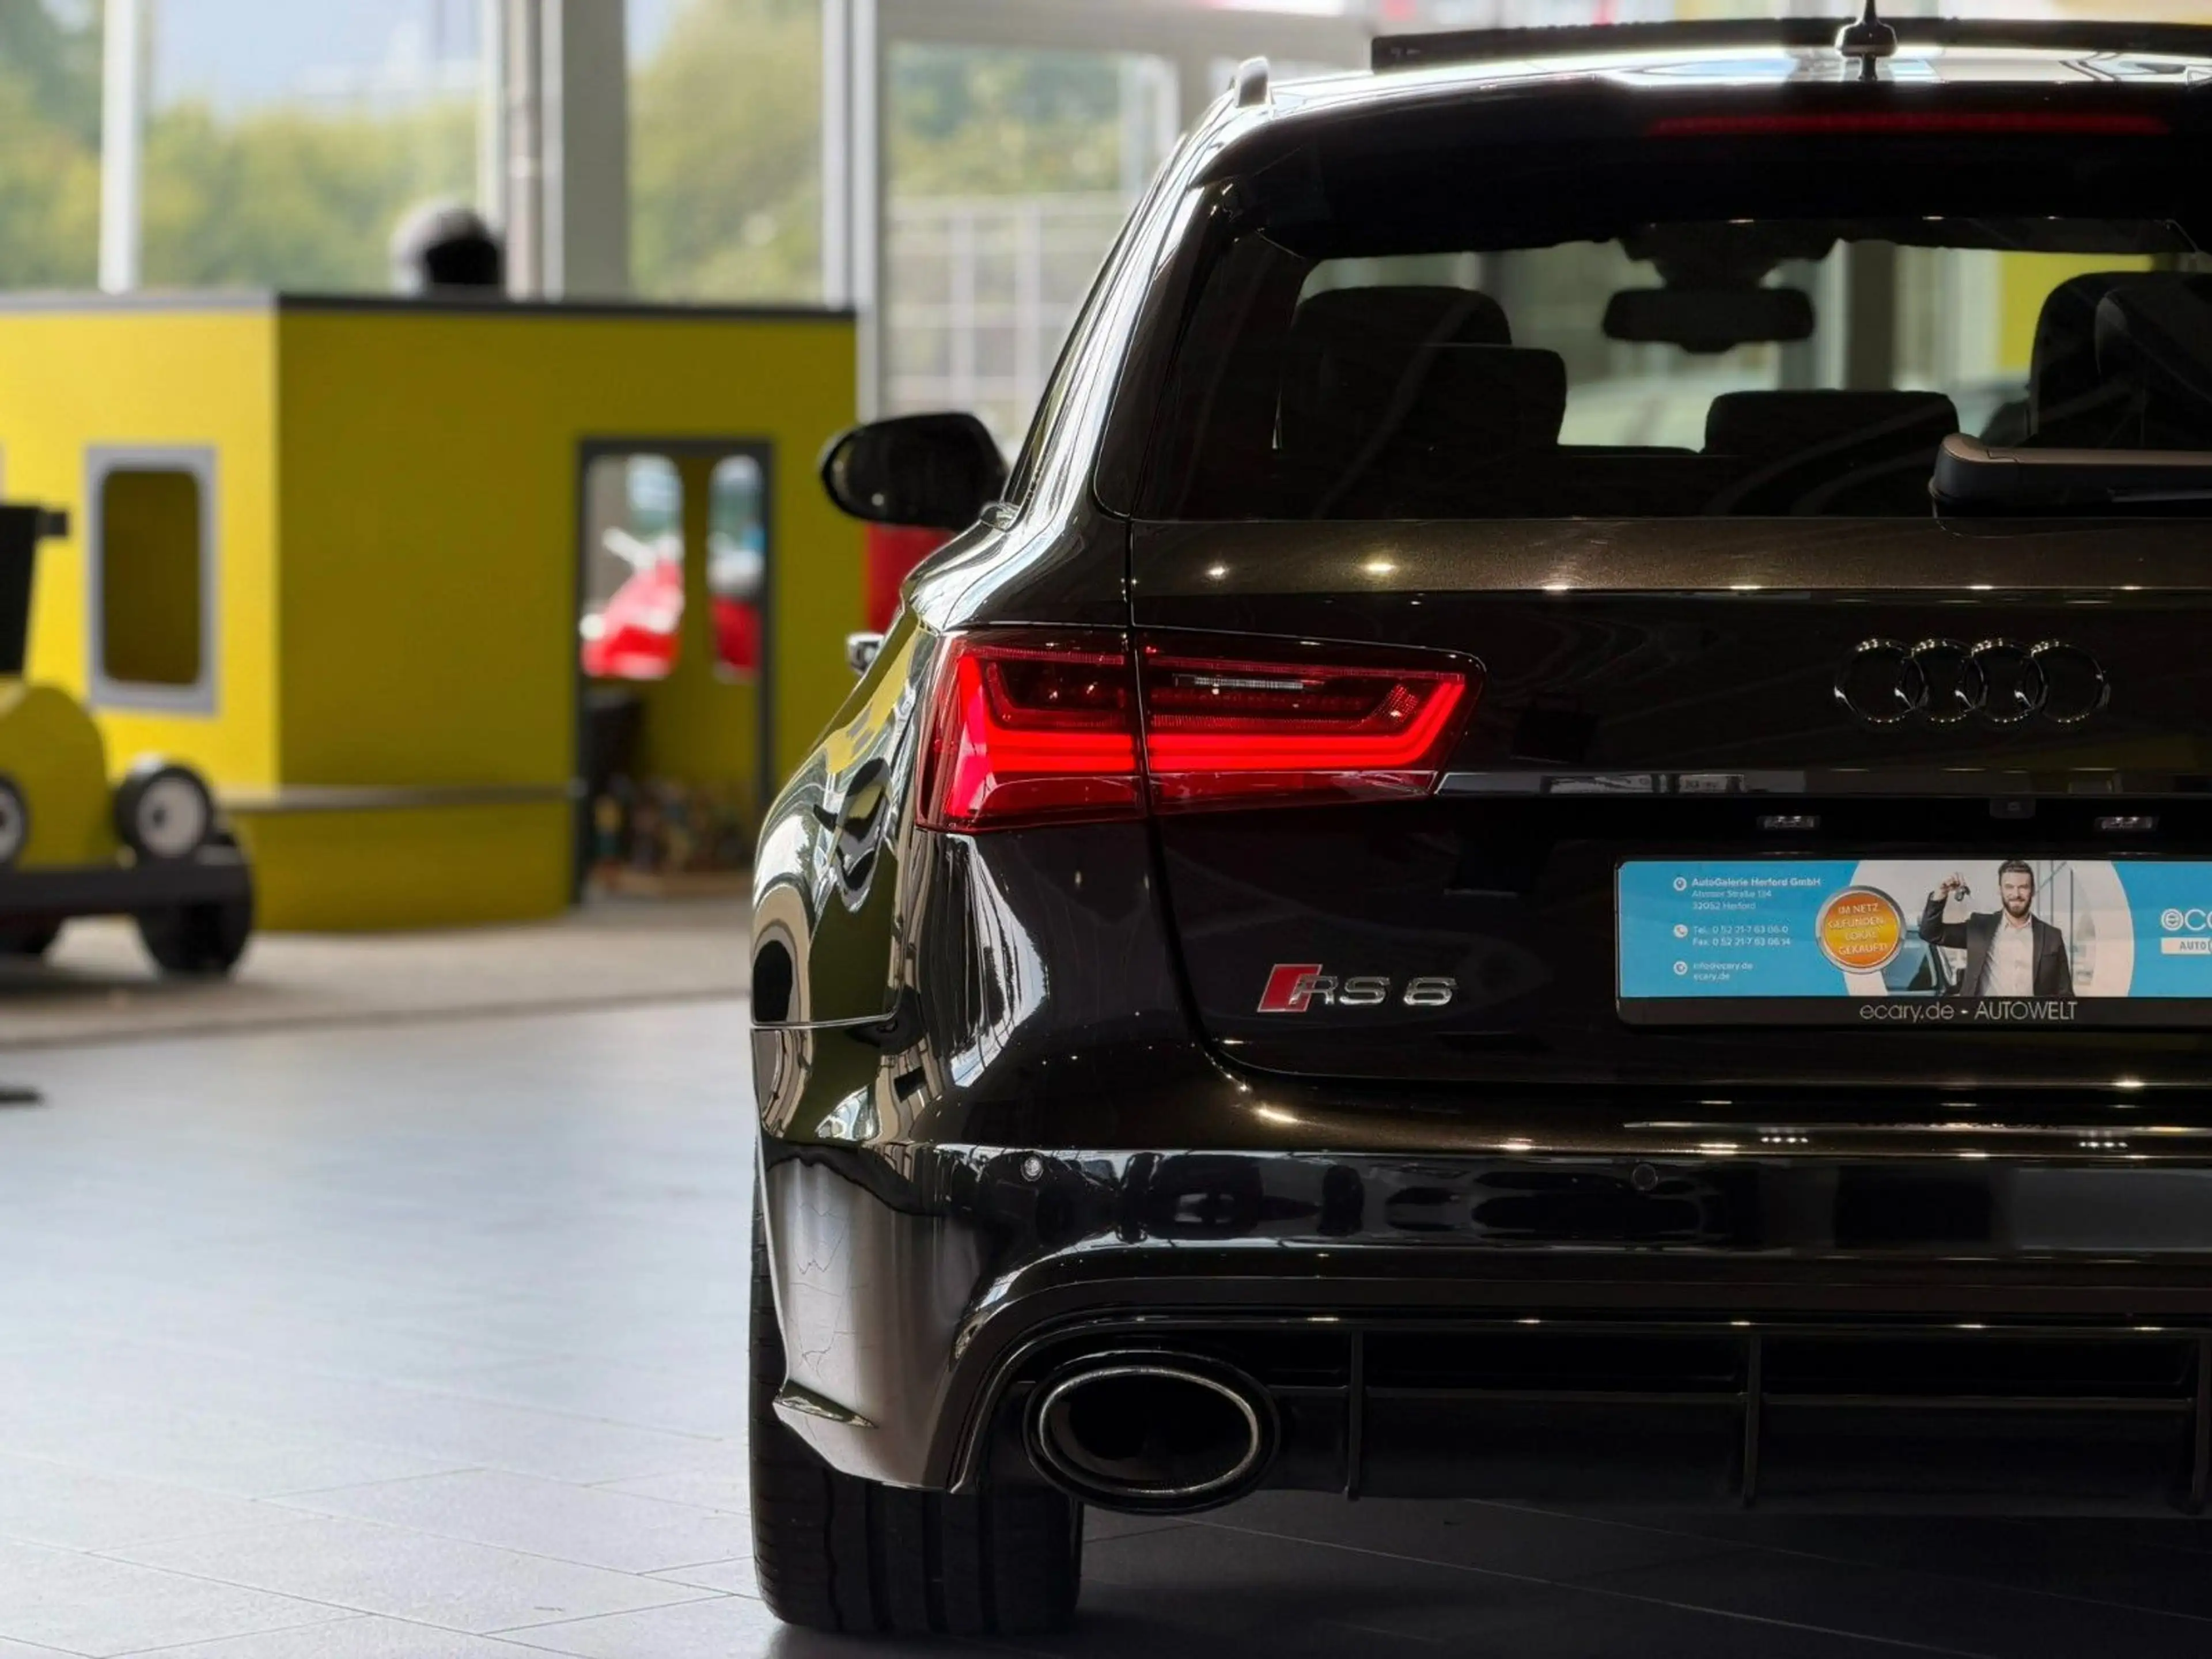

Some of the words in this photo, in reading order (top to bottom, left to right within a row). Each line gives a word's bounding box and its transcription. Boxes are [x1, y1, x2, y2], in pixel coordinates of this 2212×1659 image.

[1789, 877, 1821, 887] GmbH
[1853, 903, 1879, 914] NETZ
[2161, 908, 2212, 931] ec
[1289, 975, 1391, 1005] RS
[1403, 976, 1459, 1006] 6
[1859, 1001, 1955, 1022] ecary.de
[1974, 1001, 2078, 1020] AUTOWELT
